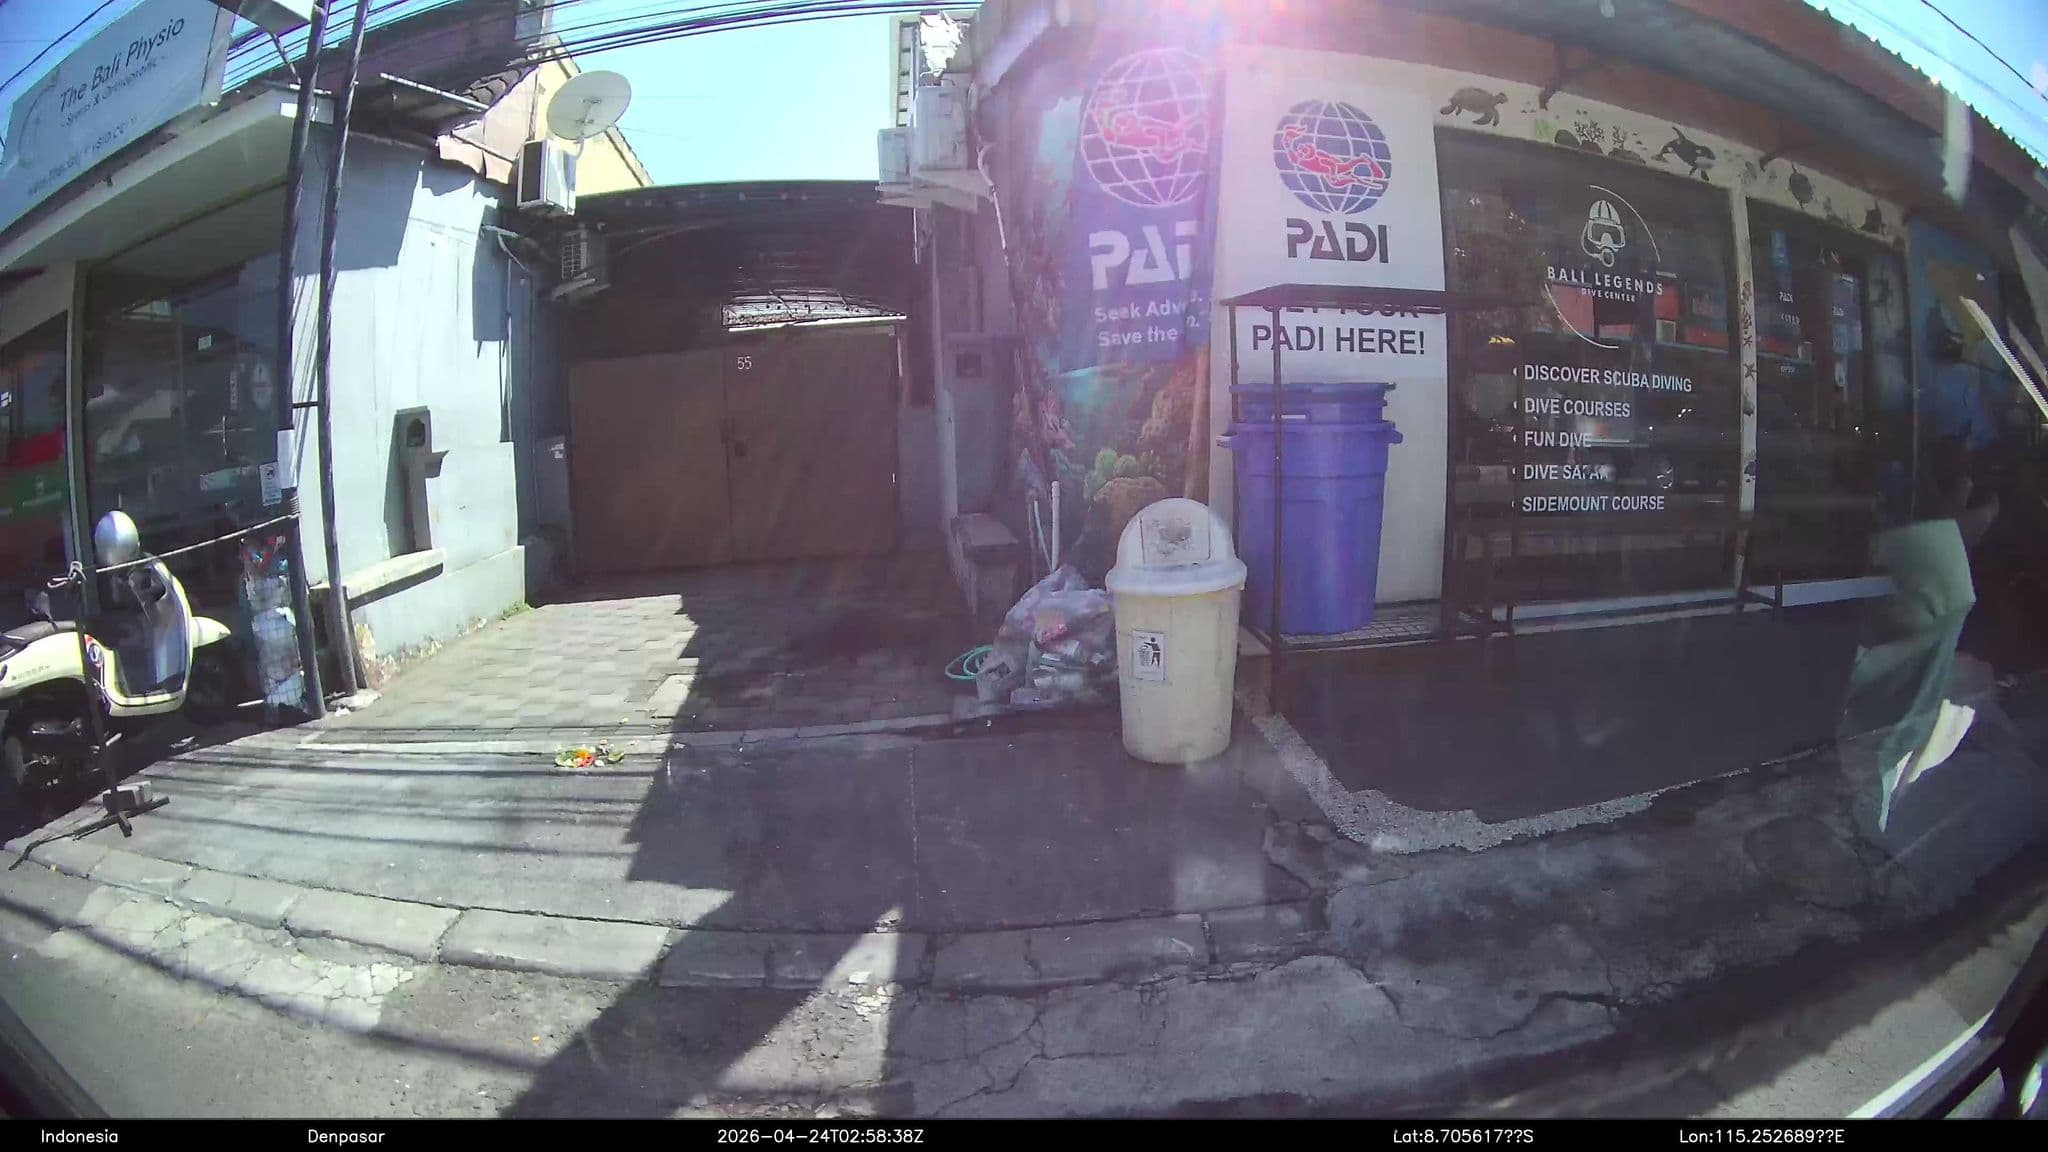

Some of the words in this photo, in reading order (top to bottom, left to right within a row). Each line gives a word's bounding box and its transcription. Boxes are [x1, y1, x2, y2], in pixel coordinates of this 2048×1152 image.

[61, 82, 87, 112] The
[91, 53, 122, 91] Bali
[125, 18, 185, 67] Physio
[1287, 218, 1389, 264] PADI
[1547, 266, 1585, 284] BALI
[1595, 272, 1664, 296] LEGENDS
[1581, 287, 1602, 298] DIVE
[1604, 290, 1636, 303] CENTER
[1094, 302, 1141, 322] Seek
[1097, 332, 1142, 347] Save
[1148, 325, 1178, 342] the
[1252, 325, 1324, 351] PADI
[1336, 328, 1425, 355] HERE!
[737, 356, 752, 369] 55
[1524, 364, 1600, 384] DISCOVER
[1603, 370, 1649, 389] SCUBA
[1652, 374, 1692, 392] DIVING
[1525, 397, 1560, 415] DIVE
[1563, 399, 1631, 418] COURSES
[1524, 430, 1555, 447] FUN
[1559, 431, 1592, 448] DIVE
[1523, 464, 1559, 480] DIVE
[1522, 496, 1608, 512] SIDEMOUNT
[1611, 496, 1666, 511] COURSE
